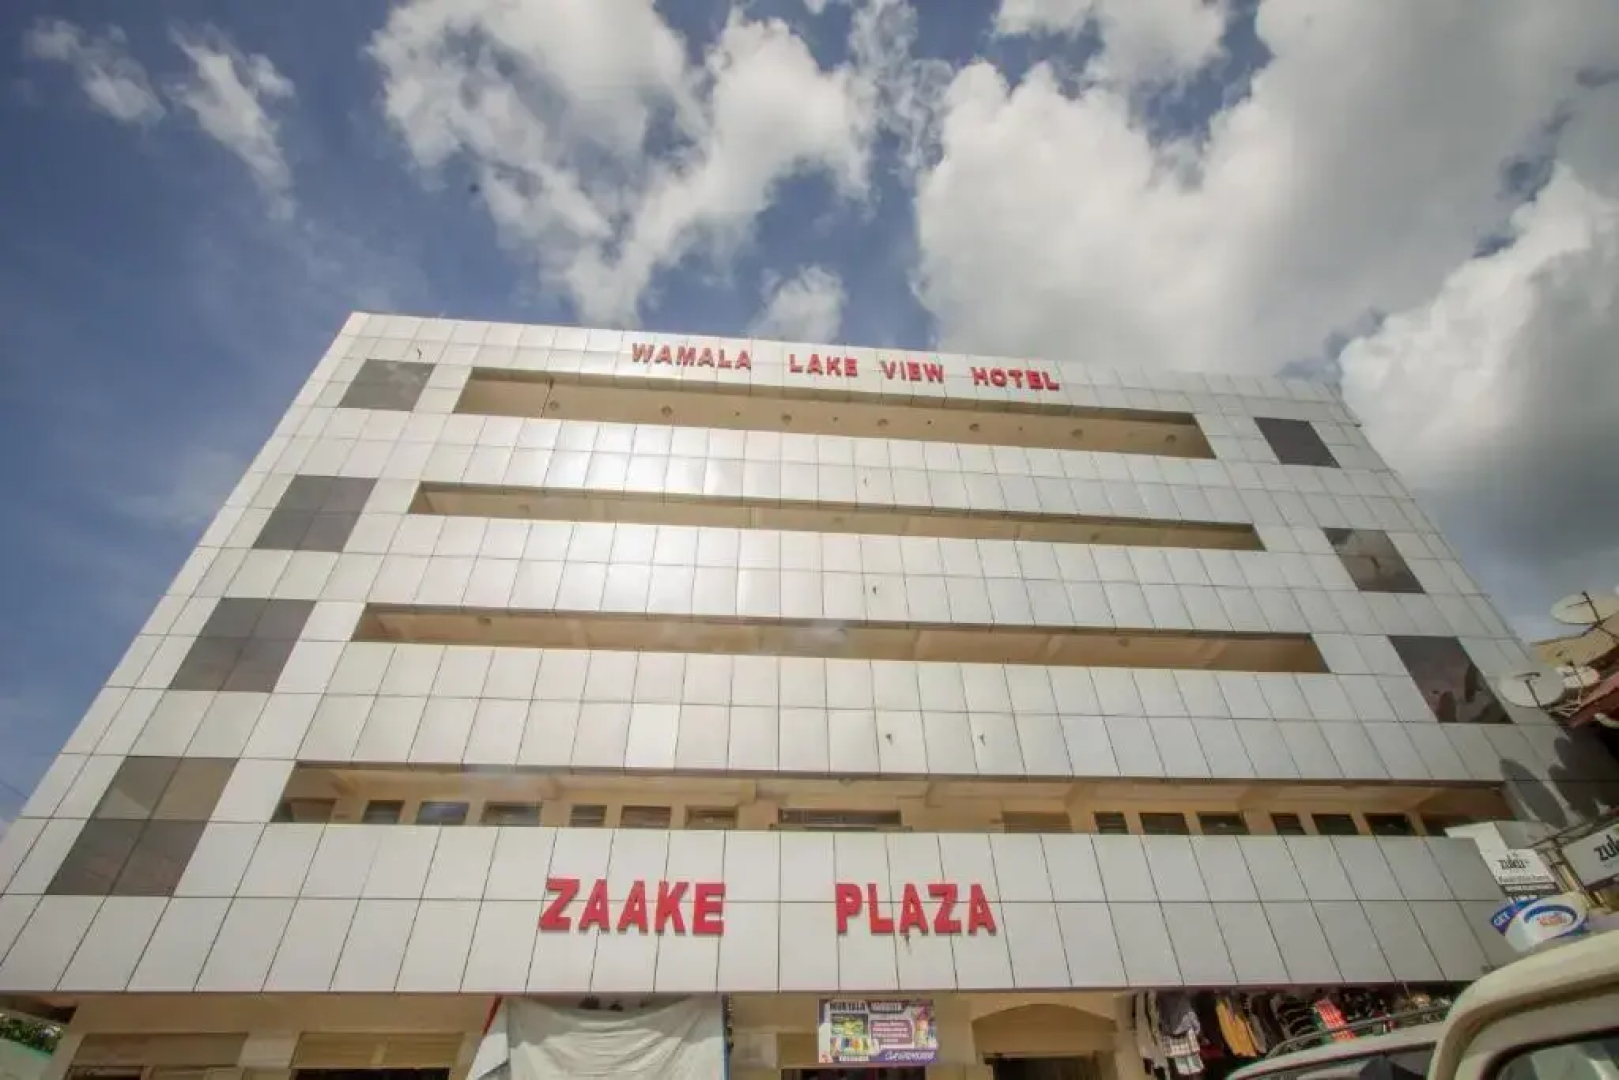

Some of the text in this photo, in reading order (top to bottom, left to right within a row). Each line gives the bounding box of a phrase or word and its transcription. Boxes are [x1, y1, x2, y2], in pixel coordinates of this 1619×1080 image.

[632, 343, 1060, 391] WAMALA LAKE VIEW HOTEL
[538, 877, 997, 935] ZAAKE PLAZA
